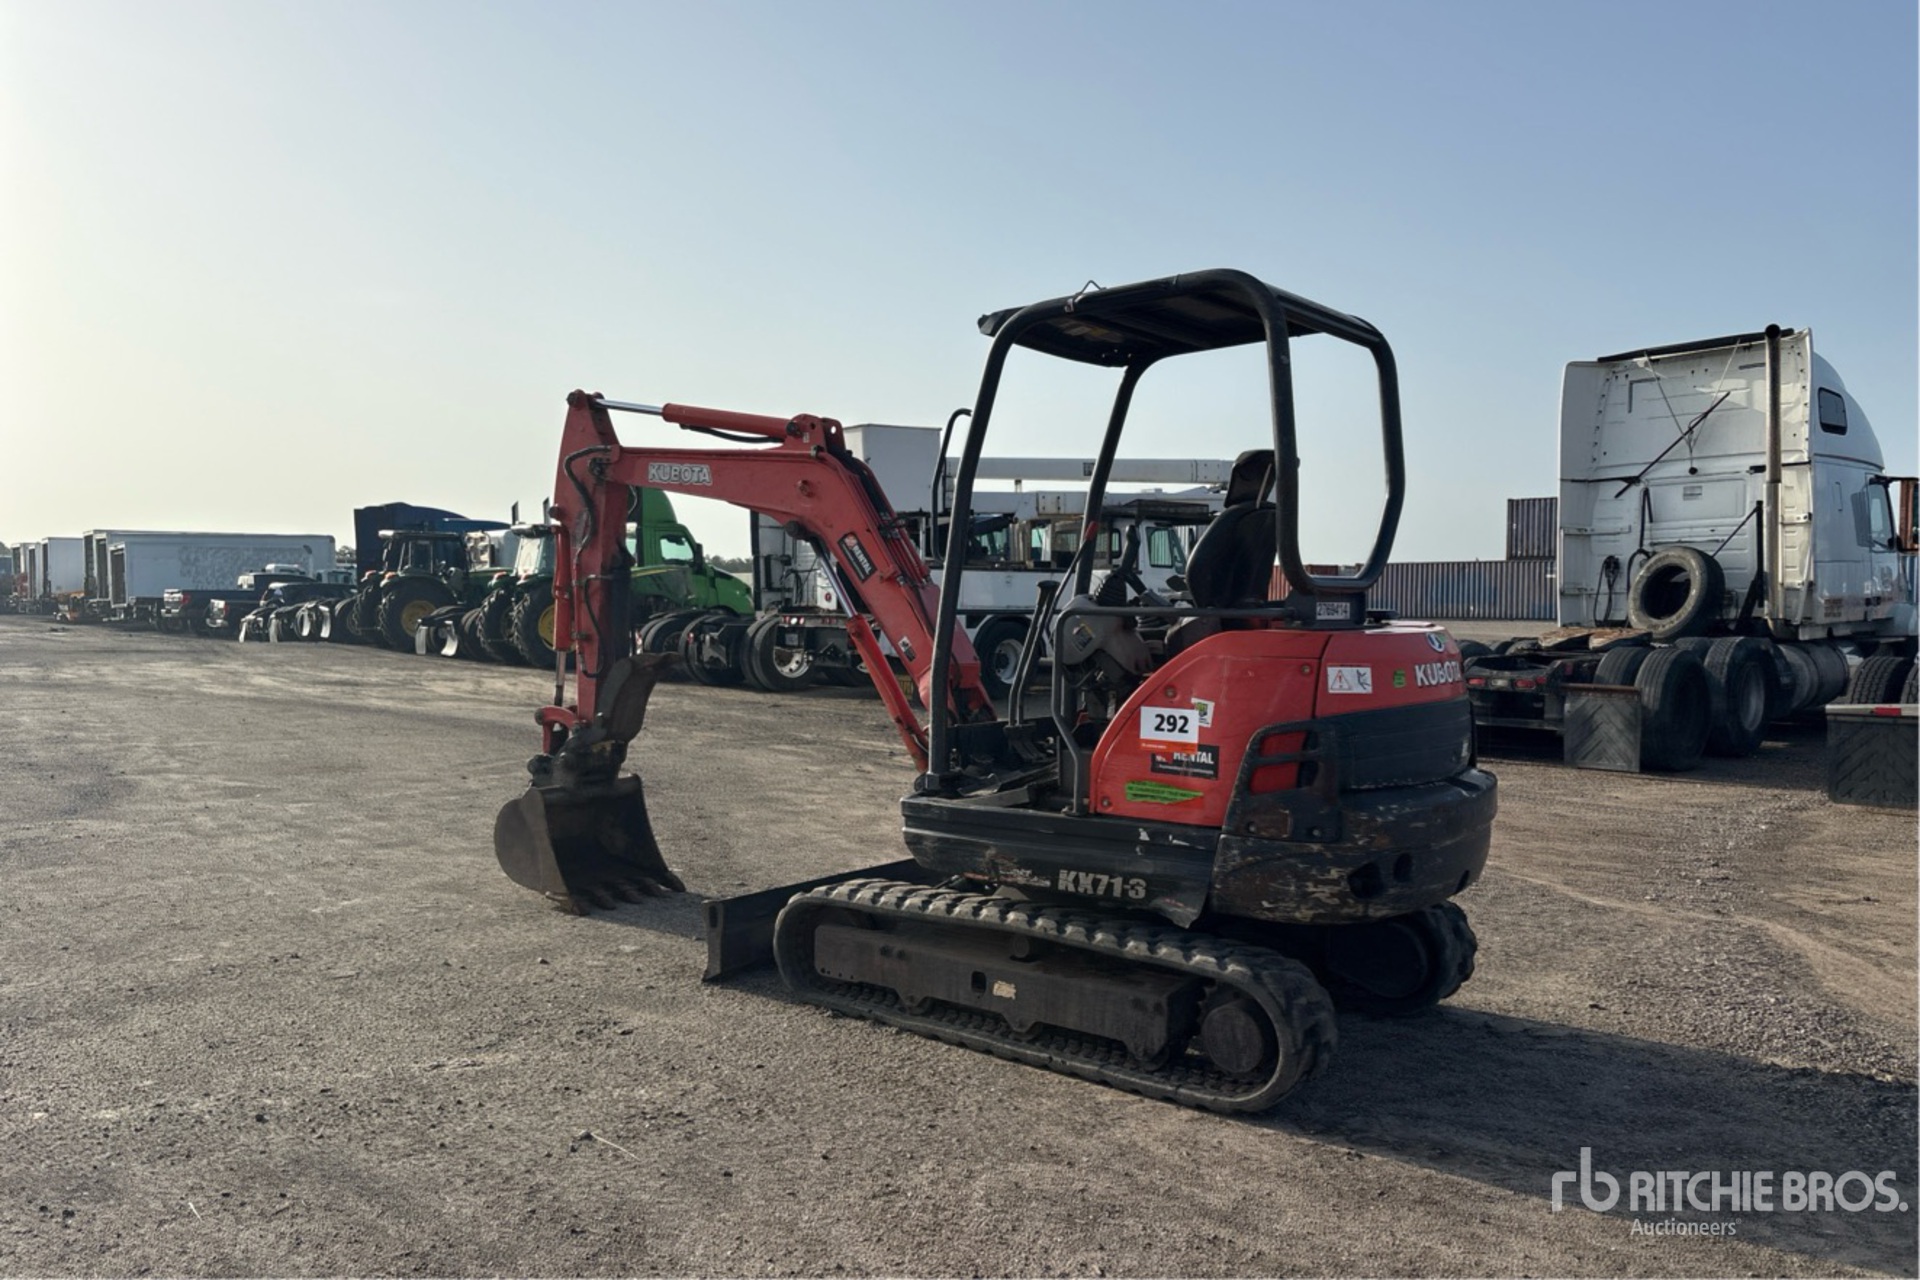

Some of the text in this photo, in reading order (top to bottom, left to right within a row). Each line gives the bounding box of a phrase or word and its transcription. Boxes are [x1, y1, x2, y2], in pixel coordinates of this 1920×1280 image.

[649, 462, 713, 486] KUBOTA
[1414, 661, 1461, 687] KUBOTA
[1154, 713, 1189, 734] 292
[1057, 869, 1148, 899] KX71-3
